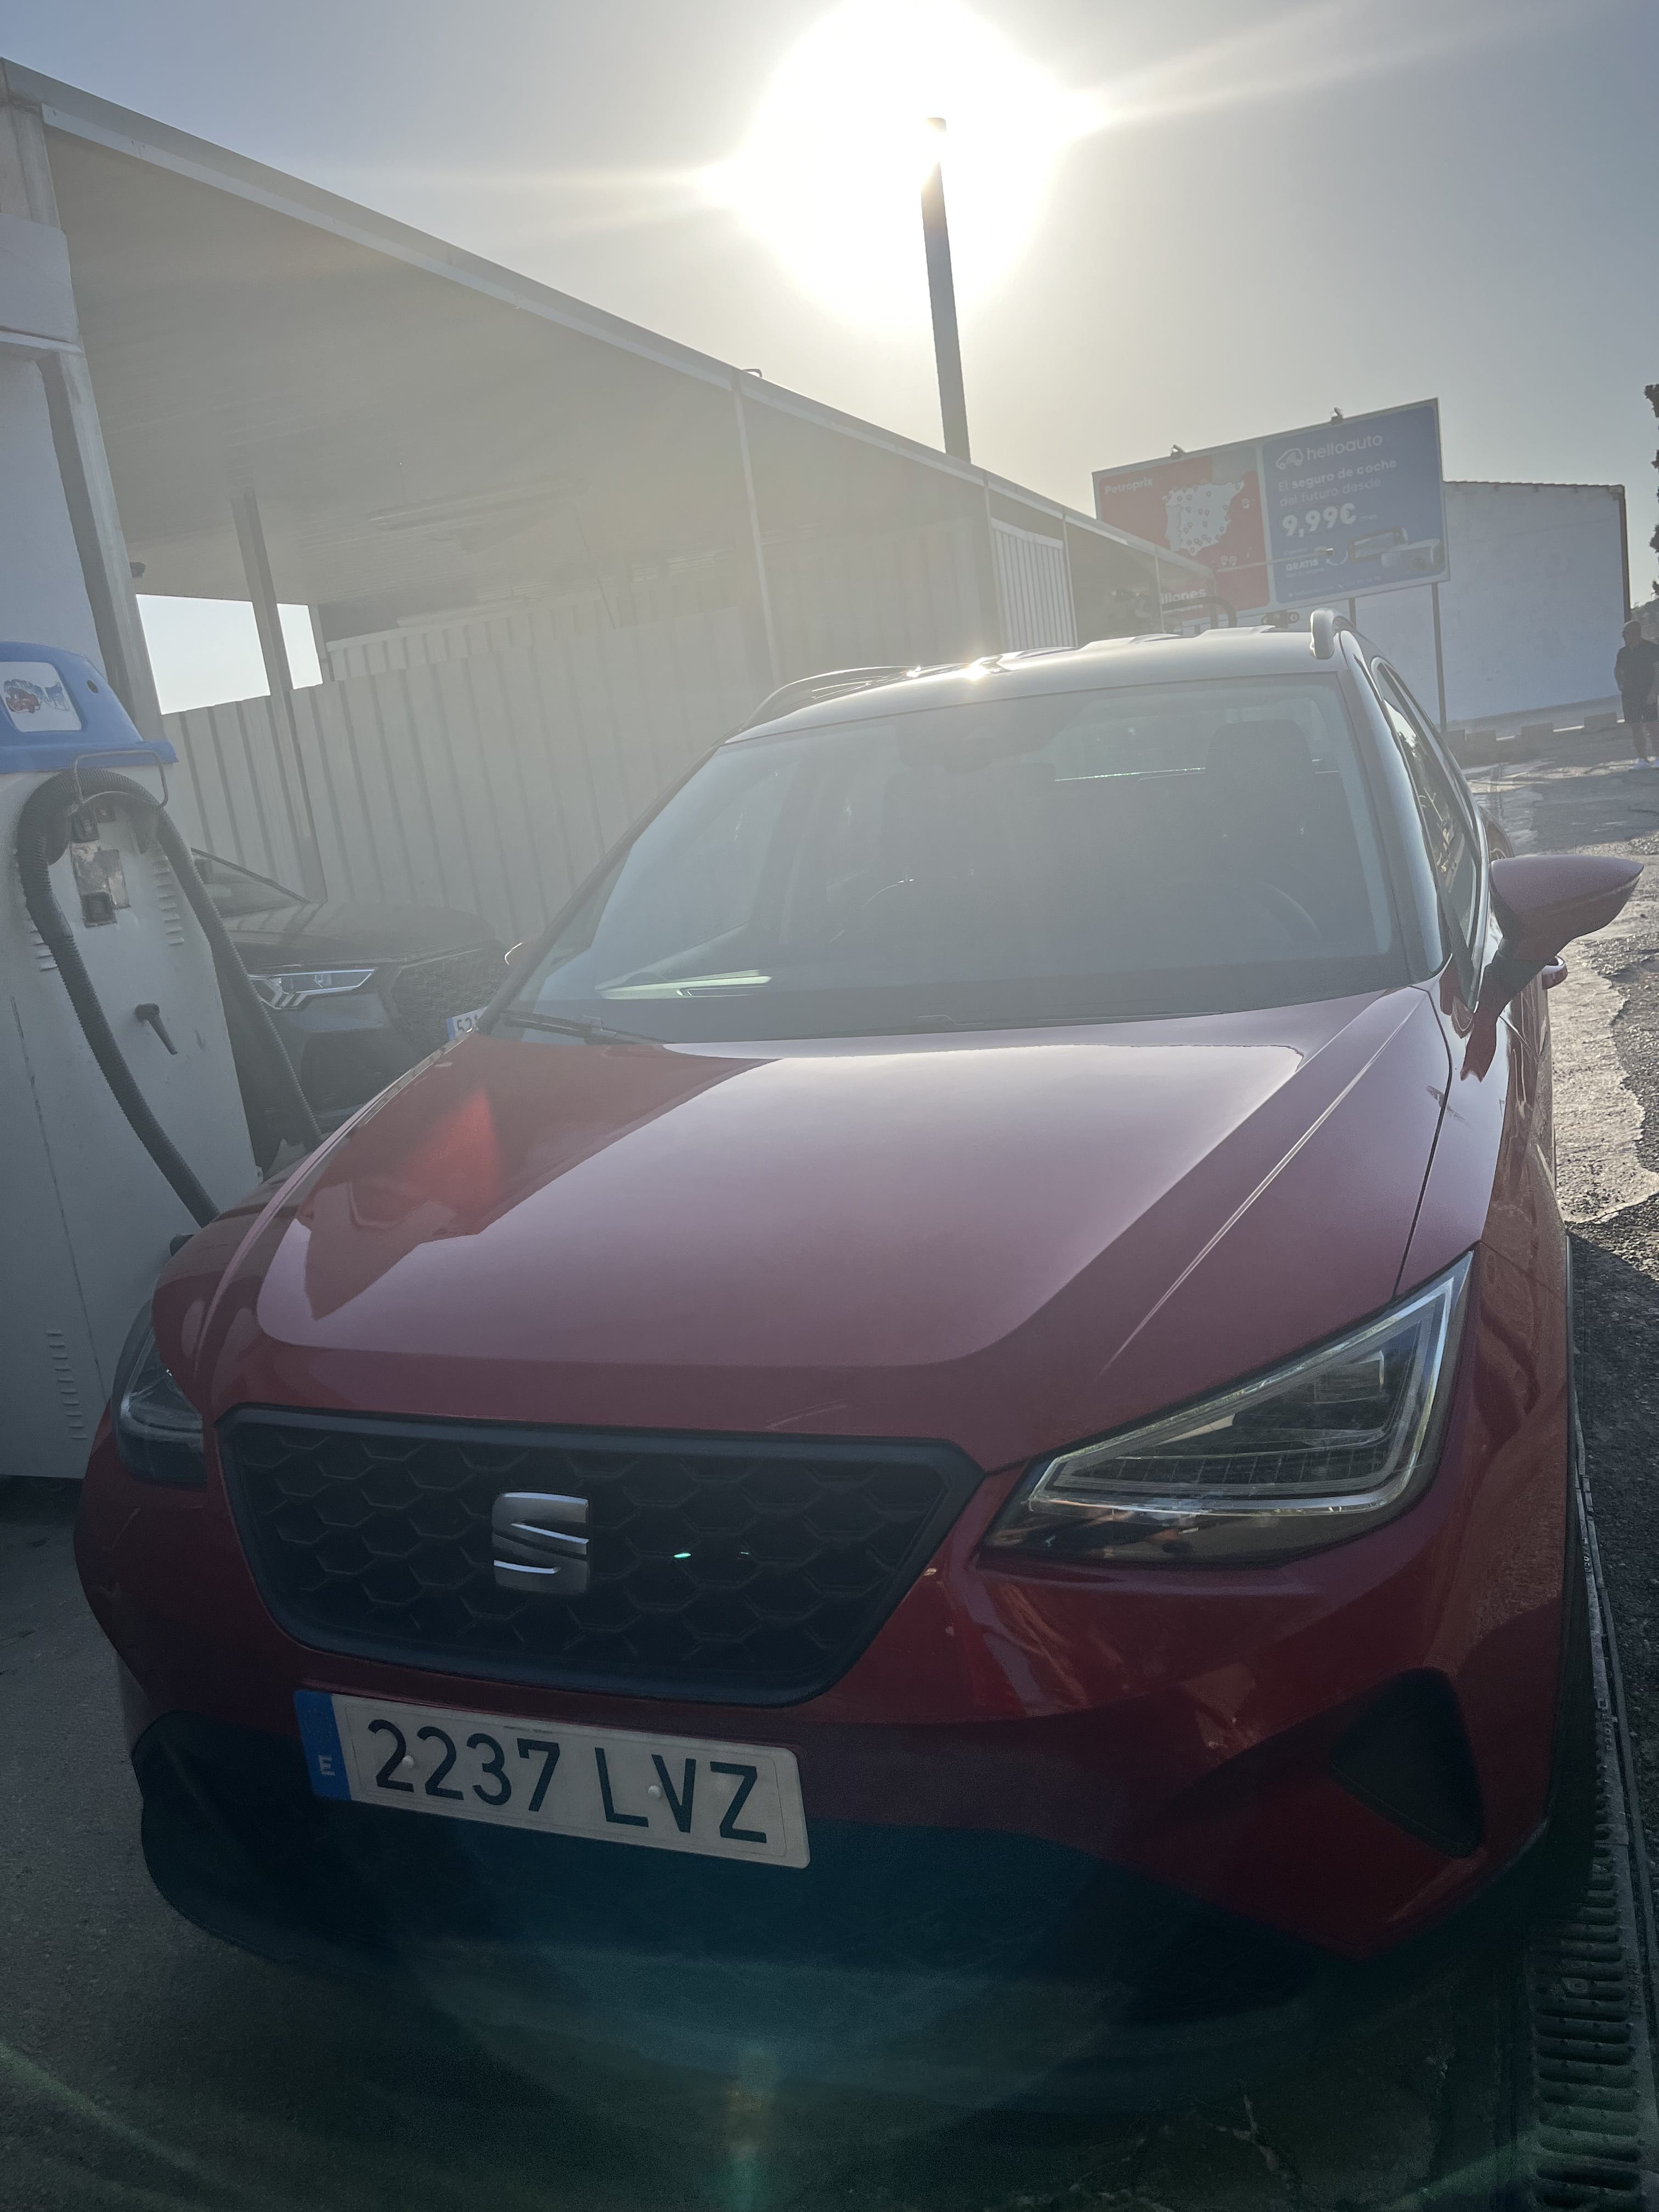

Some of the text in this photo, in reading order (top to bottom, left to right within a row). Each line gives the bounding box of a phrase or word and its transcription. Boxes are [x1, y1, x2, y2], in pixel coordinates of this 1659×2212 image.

[1306, 435, 1383, 461] helloauto
[1104, 476, 1154, 495] Petroprix
[1278, 459, 1397, 492] El seguro de coche
[1280, 477, 1381, 506] del futuro desde
[1282, 503, 1357, 538] 9,99€
[1286, 558, 1318, 571] GRATIS
[1160, 588, 1207, 605] illones
[318, 1754, 335, 1777] E
[368, 1719, 767, 1843] 2237 LVZ
